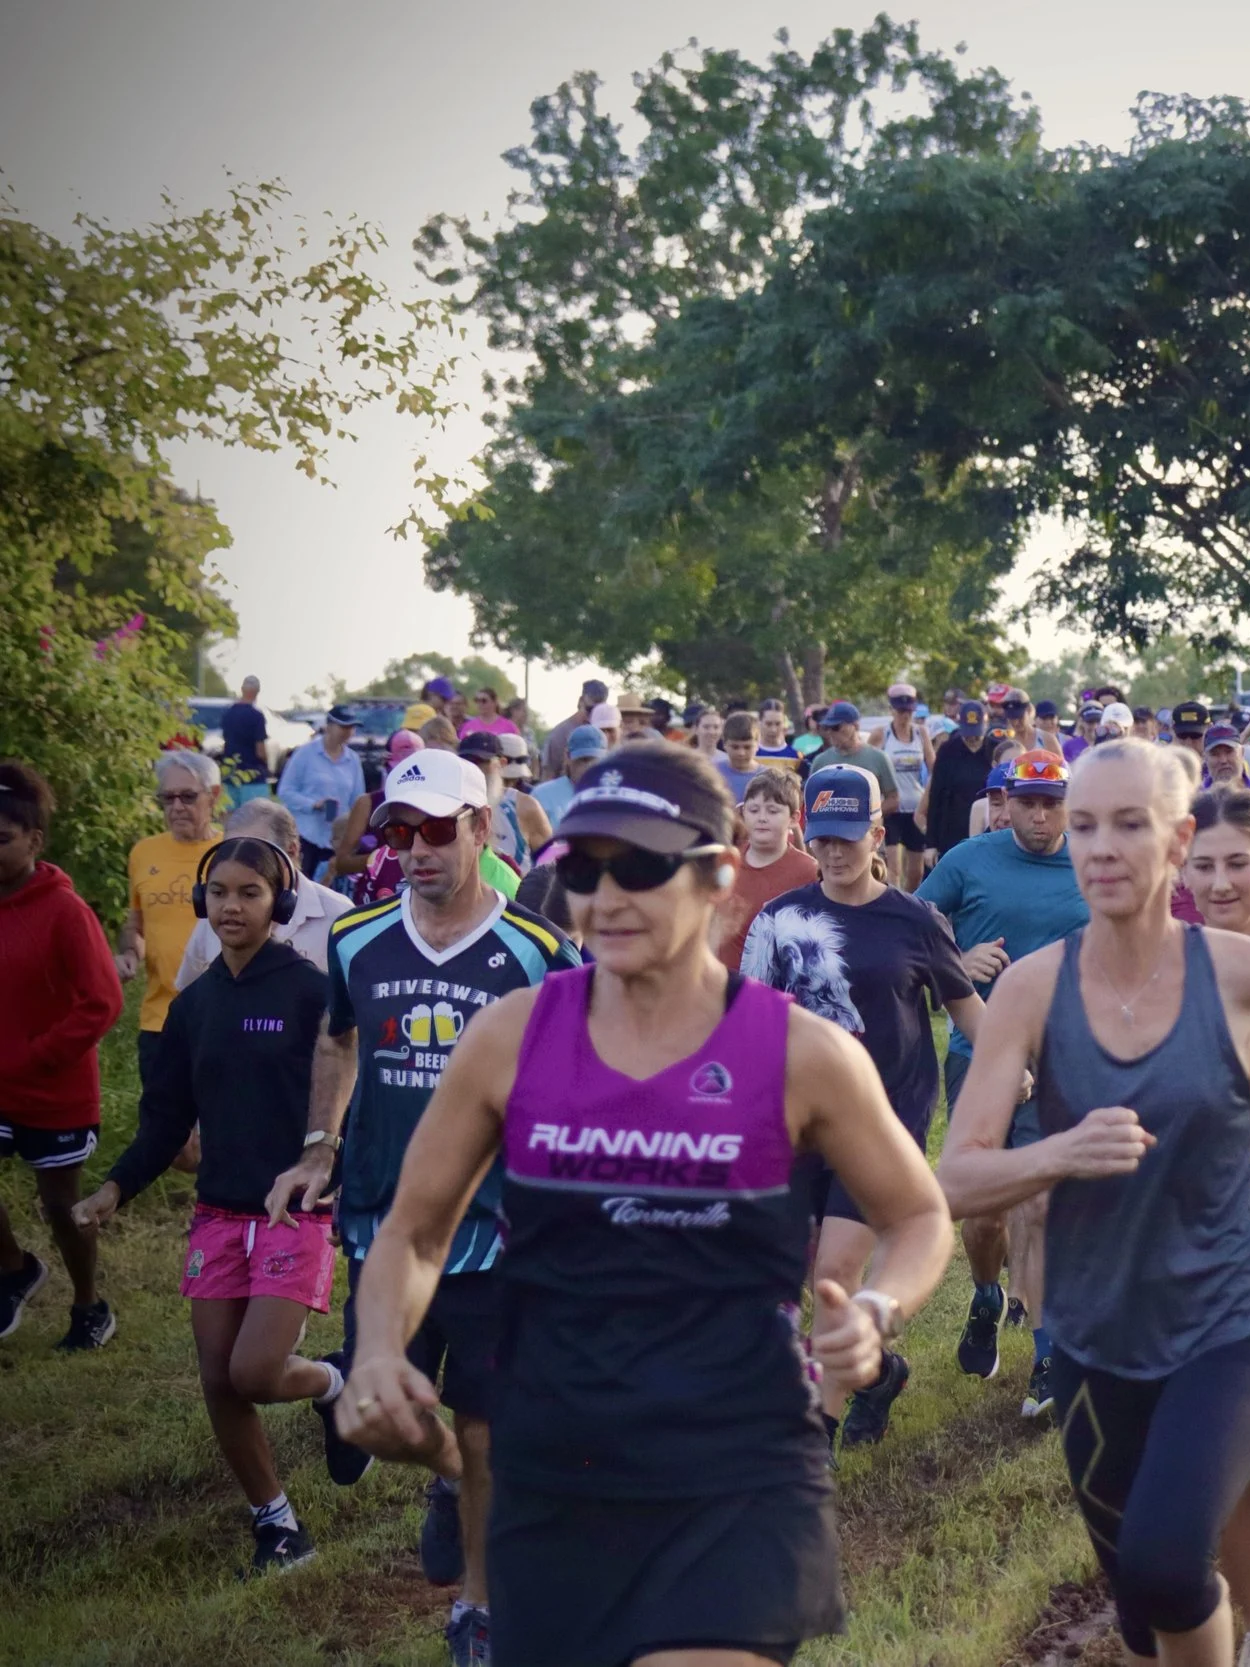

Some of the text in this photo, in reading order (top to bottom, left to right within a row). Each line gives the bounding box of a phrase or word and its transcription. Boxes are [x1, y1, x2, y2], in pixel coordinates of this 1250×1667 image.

[397, 774, 426, 785] adidas
[244, 1019, 284, 1032] FLYING
[380, 1068, 442, 1089] RUNN
[528, 1123, 743, 1162] RUNNING
[550, 1154, 731, 1187] WORKS
